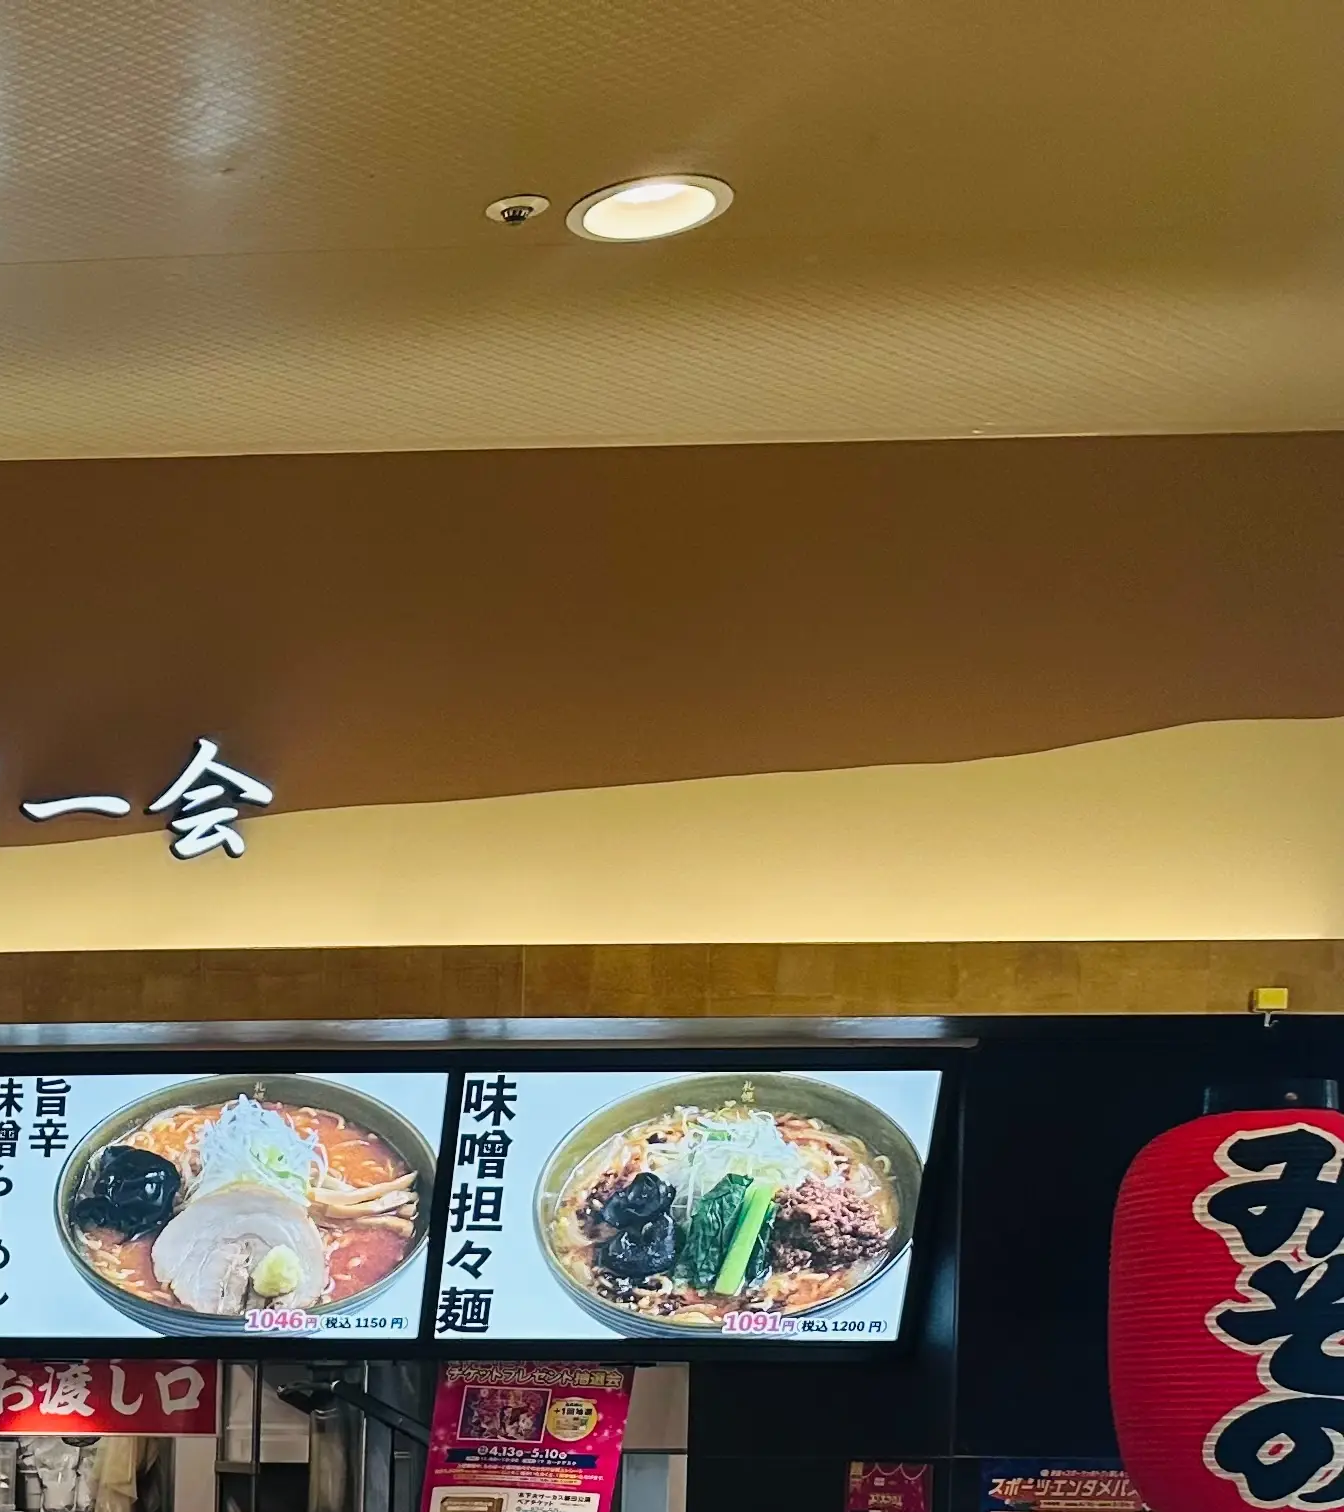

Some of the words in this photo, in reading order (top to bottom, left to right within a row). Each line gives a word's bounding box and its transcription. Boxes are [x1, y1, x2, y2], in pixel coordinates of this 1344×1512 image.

[29, 1077, 71, 1158] 旨辛
[435, 1074, 518, 1335] 味噌担々麺
